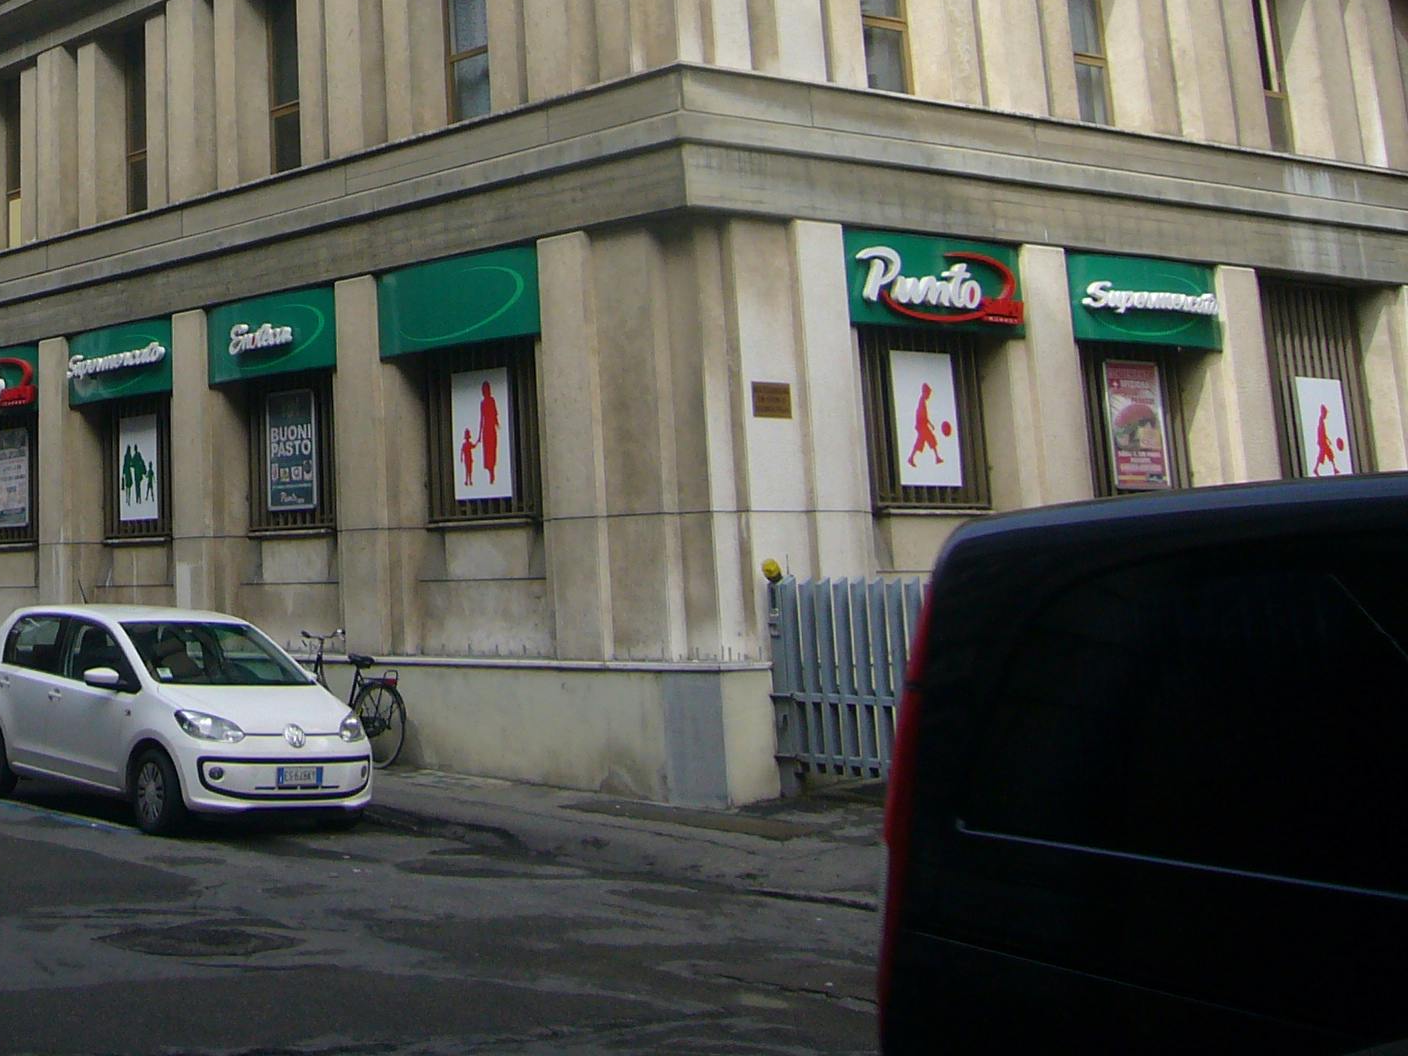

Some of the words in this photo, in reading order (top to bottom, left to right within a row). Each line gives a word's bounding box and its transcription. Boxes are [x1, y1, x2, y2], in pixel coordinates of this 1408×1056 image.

[855, 246, 982, 309] Punto
[271, 424, 312, 443] BUONI
[271, 439, 312, 458] PASTO
